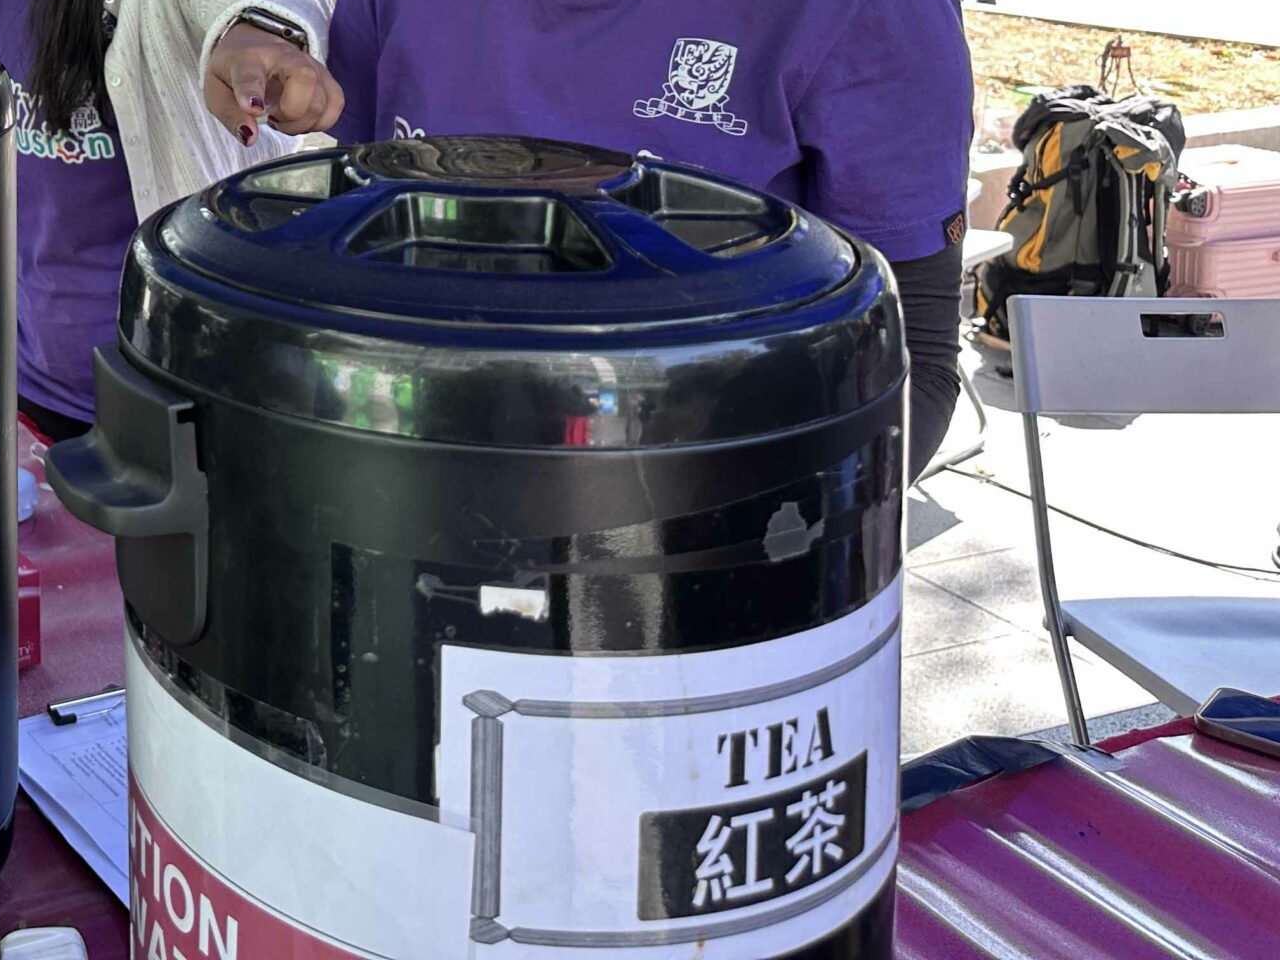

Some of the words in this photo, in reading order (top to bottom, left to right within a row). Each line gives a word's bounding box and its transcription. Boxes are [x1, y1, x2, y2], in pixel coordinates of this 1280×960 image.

[17, 122, 115, 164] usion
[716, 706, 835, 788] TEA
[691, 779, 846, 907] 紅茶
